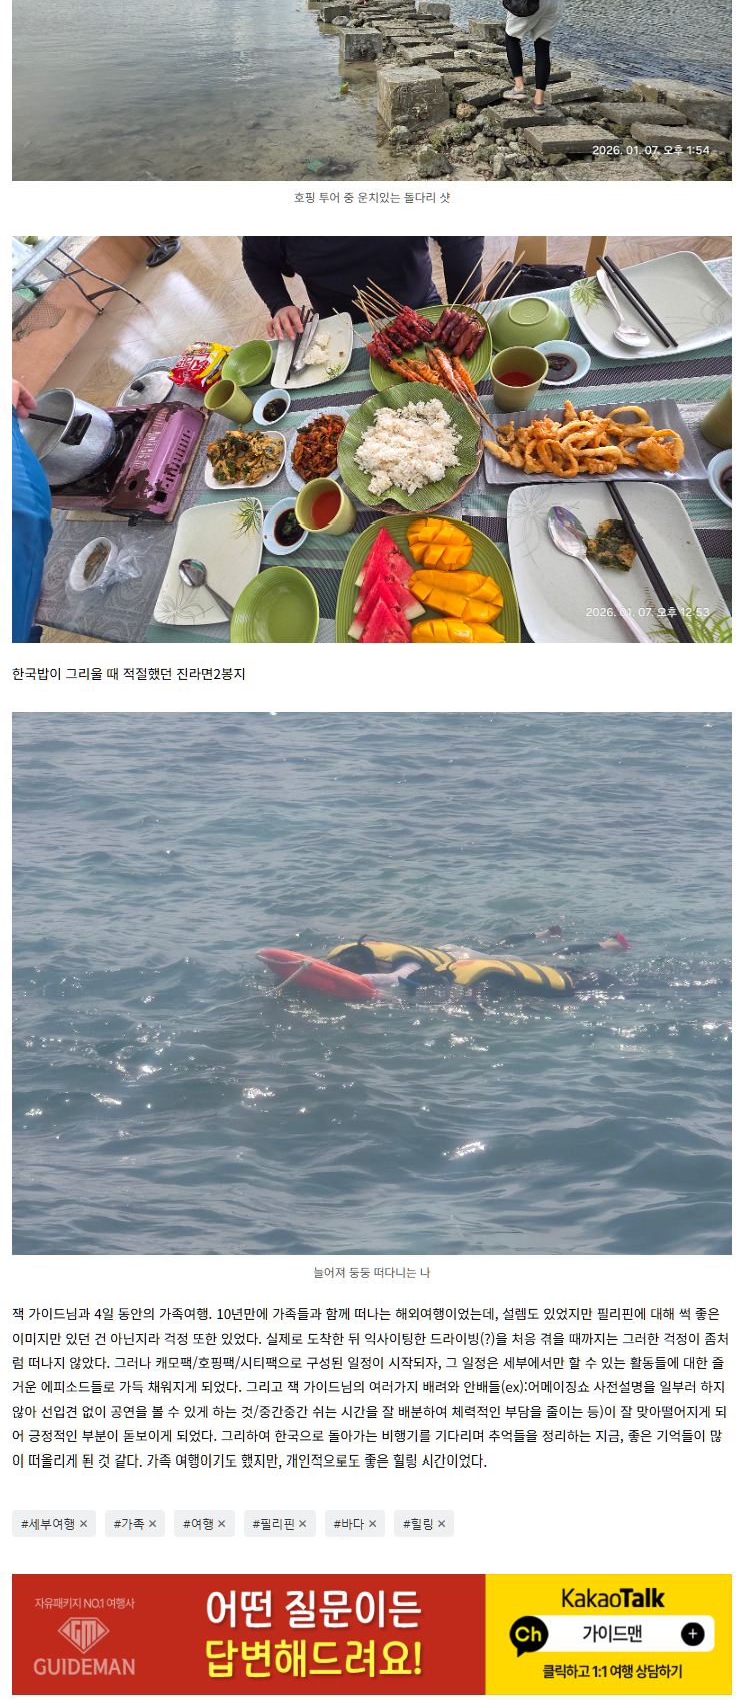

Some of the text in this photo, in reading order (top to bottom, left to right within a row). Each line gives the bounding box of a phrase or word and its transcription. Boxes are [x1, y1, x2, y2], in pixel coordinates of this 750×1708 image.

[35, 1598, 135, 1609] 자유패키지 NO.1 여행사
[563, 1588, 664, 1607] KakaoTalk
[207, 1590, 421, 1628] 어떤 질문이든
[516, 1627, 541, 1641] Ch
[583, 1625, 642, 1642] 가이드맨
[34, 1658, 135, 1675] GUIDEMAN
[206, 1640, 421, 1677] 답변해드려요!
[543, 1664, 682, 1678] 클릭하고 1:1 여행 상담하기
